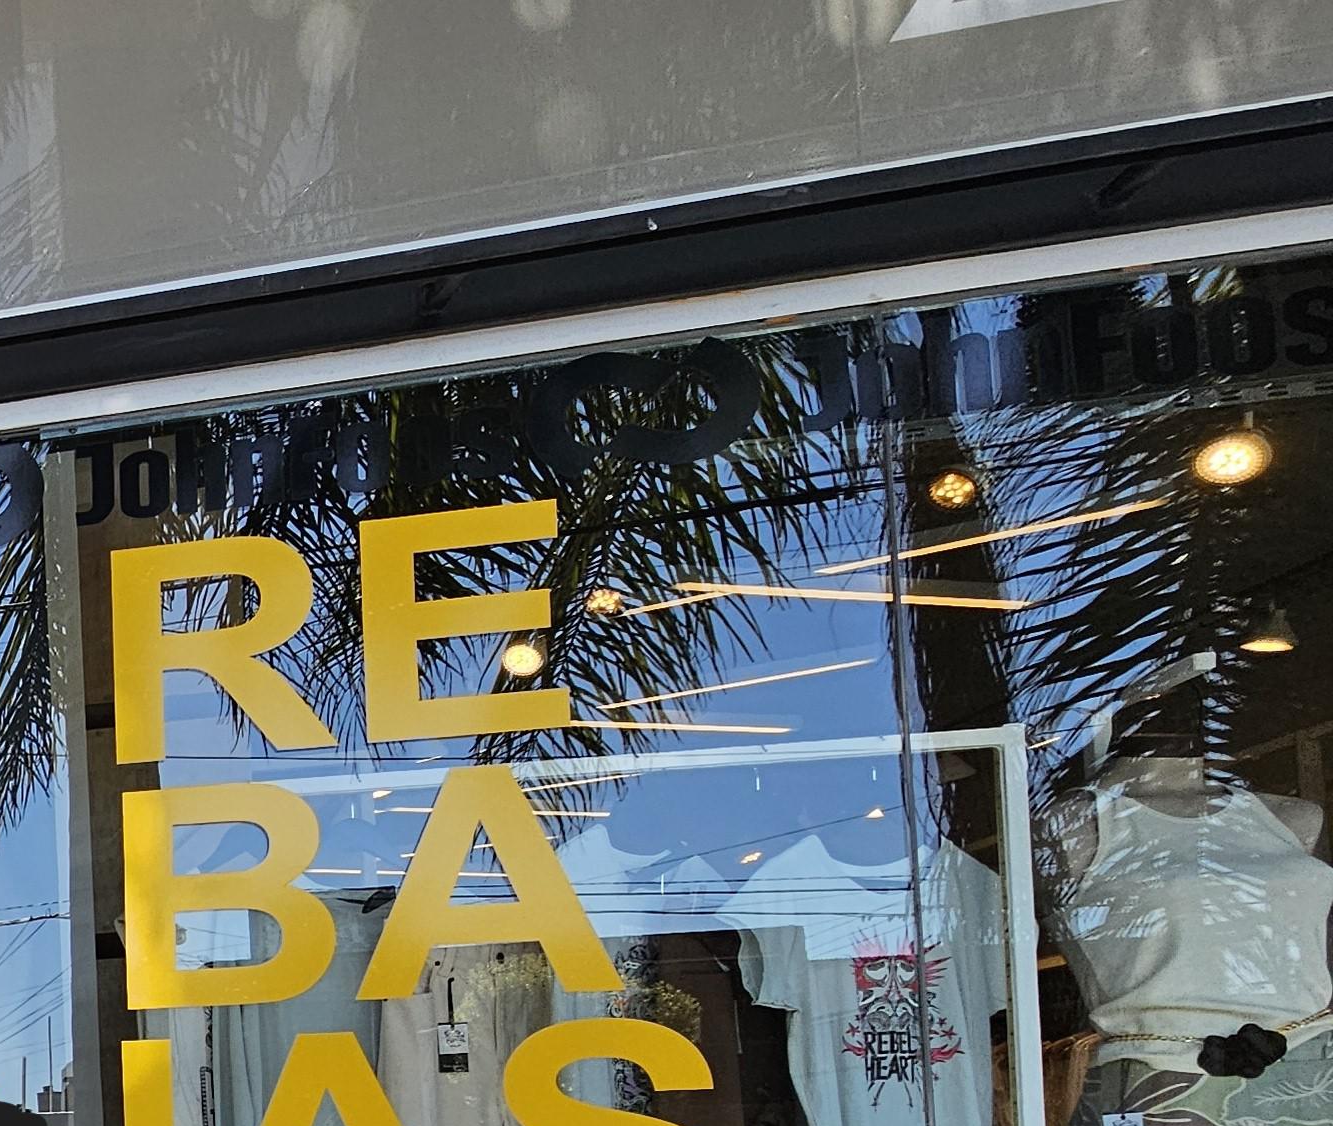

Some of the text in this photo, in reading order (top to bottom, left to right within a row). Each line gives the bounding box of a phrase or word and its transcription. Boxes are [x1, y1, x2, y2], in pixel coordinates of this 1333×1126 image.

[110, 498, 572, 766] RE
[121, 765, 624, 1011] BA
[864, 1028, 917, 1055] REBEL
[864, 1054, 919, 1084] HEART
